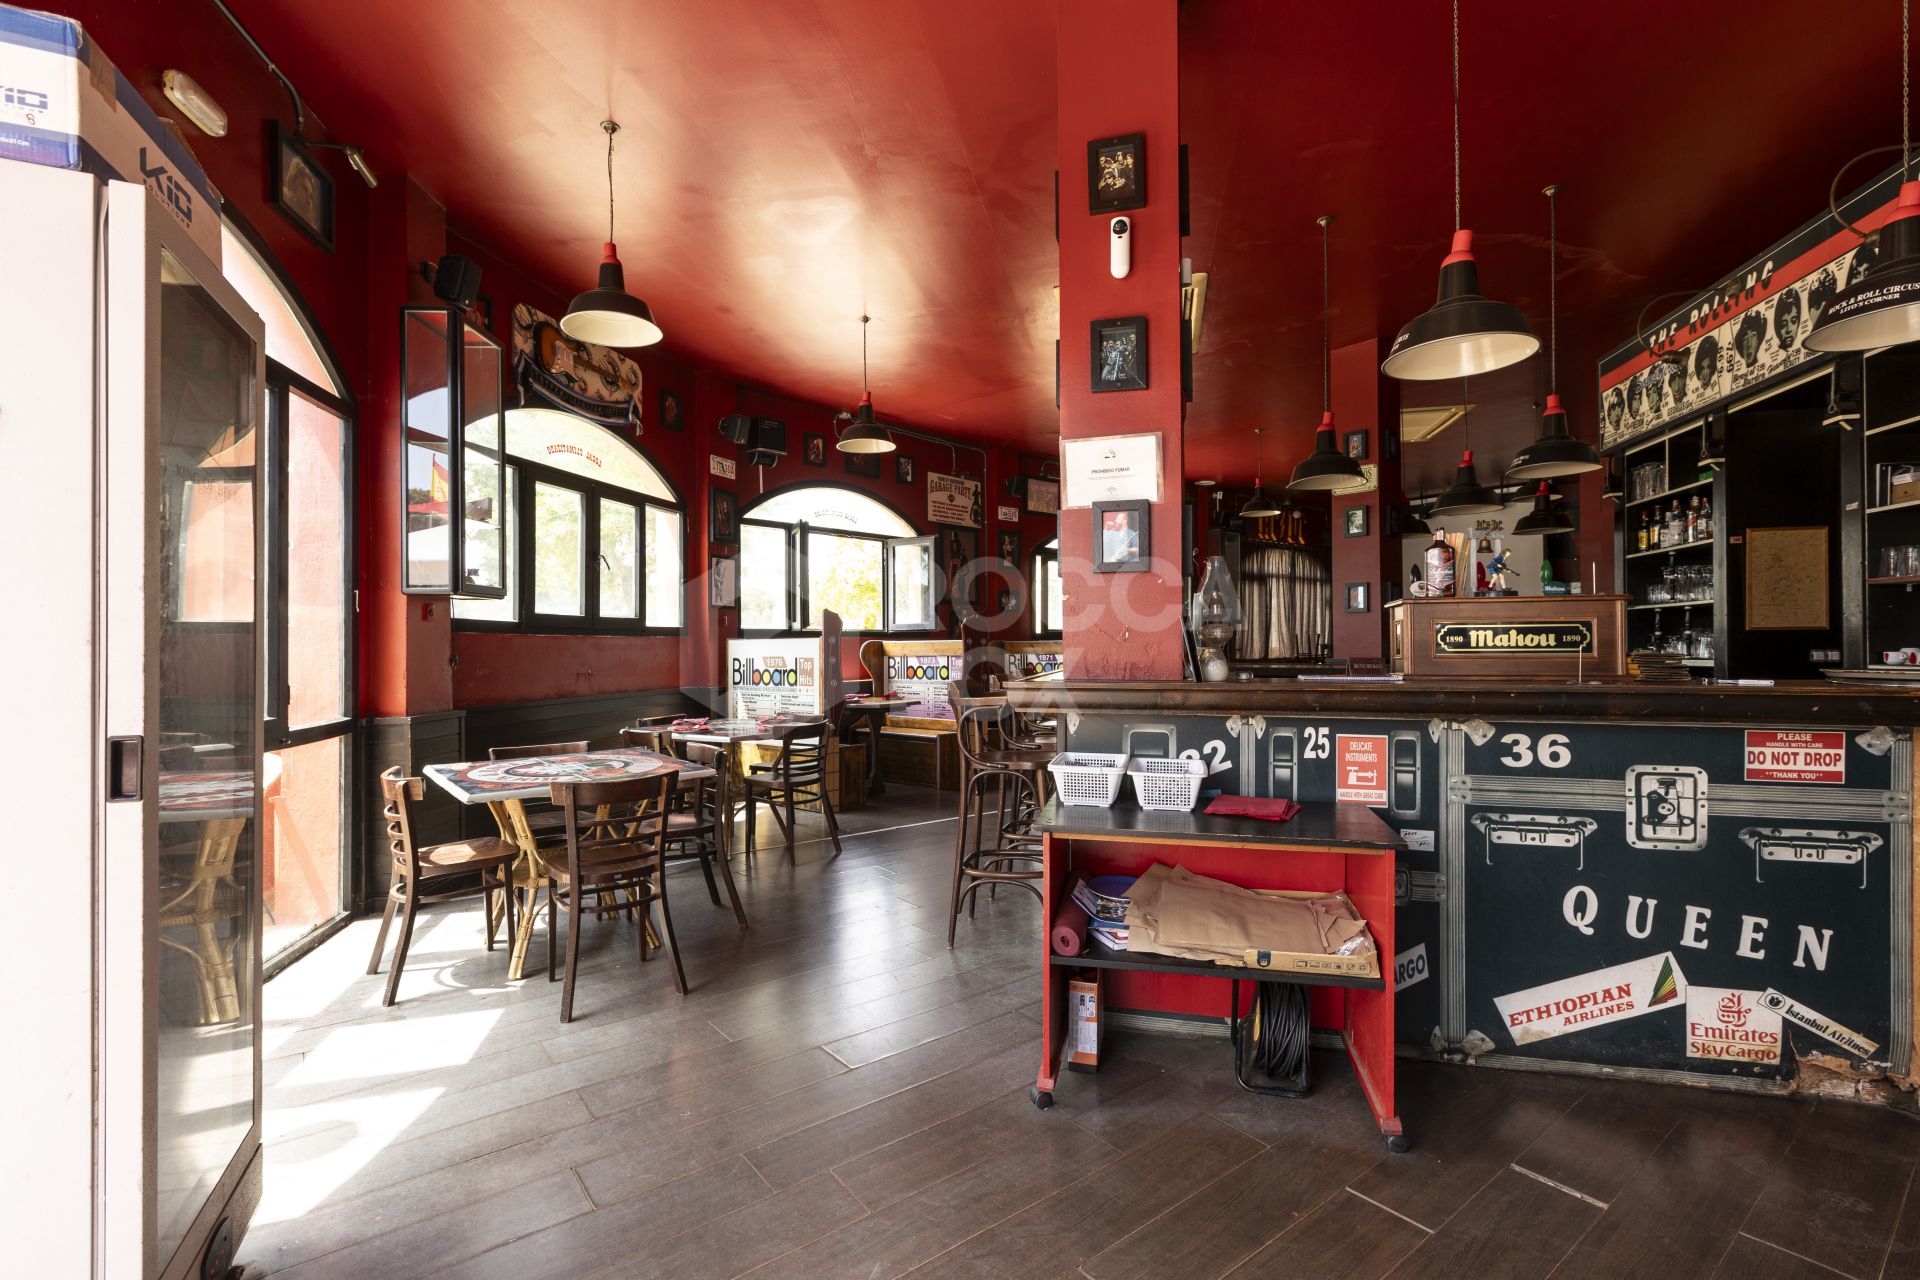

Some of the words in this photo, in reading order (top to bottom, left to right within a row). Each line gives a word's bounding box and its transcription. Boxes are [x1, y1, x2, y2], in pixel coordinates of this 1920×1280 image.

[1827, 300, 1848, 315] ROCK
[1848, 297, 1856, 305] &
[1857, 289, 1882, 301] ROLL
[1883, 282, 1920, 294] CIRCUS
[1864, 293, 1901, 305] CORNER
[929, 480, 954, 494] GARAGE
[1446, 635, 1464, 643] 1890
[1468, 629, 1557, 647] Mahou
[767, 658, 783, 667] 1976
[800, 659, 812, 669] Top
[888, 656, 950, 680] Billboard
[920, 656, 936, 664] 1973
[732, 657, 798, 687] Billboard
[951, 670, 962, 679] Hit
[1303, 726, 1330, 759] 25
[1350, 741, 1373, 751] DELICATE
[1777, 733, 1813, 741] PLEASE
[1345, 753, 1378, 763] INSTRUMENTS
[1500, 733, 1572, 768] 36
[1747, 750, 1767, 765] DO
[1771, 751, 1800, 766] NOT
[1804, 752, 1842, 767] DROP
[1562, 885, 1834, 971] QUEEN
[1507, 983, 1633, 1028] ETHIOPIAN
[1562, 1000, 1635, 1027] AIRLINES
[1690, 1022, 1778, 1045] Emirates
[1785, 1004, 1830, 1037] Istanbul
[1828, 1028, 1871, 1055] Airlines
[1690, 1042, 1778, 1062] SkyCargo
